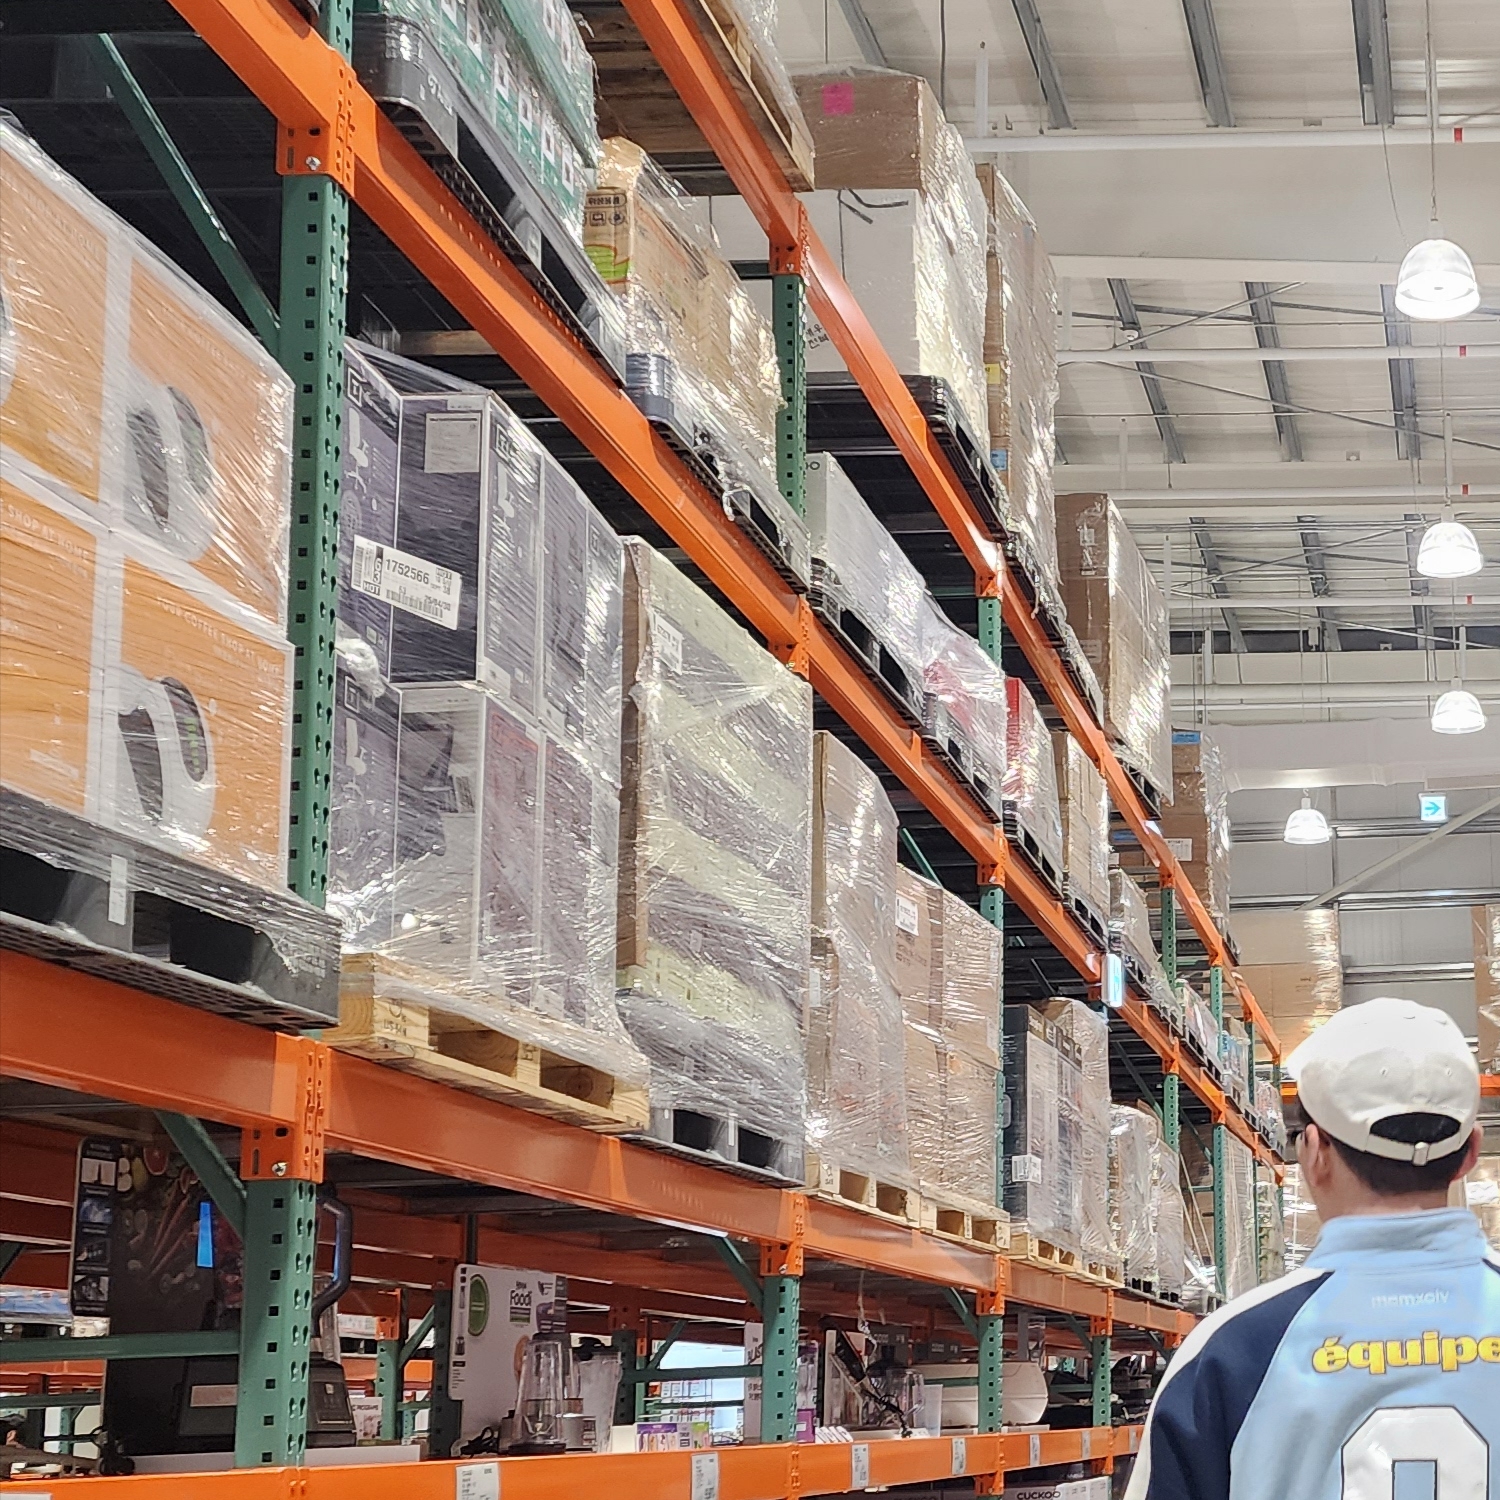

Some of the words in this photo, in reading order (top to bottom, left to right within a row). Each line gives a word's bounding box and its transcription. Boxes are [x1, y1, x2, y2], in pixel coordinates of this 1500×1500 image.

[8, 504, 38, 532] SHOP
[42, 525, 56, 543] AT
[57, 537, 89, 561] HOME
[386, 558, 430, 585] 1752566
[363, 580, 381, 596] HOT
[1017, 1490, 1061, 1500] CUCKOO
